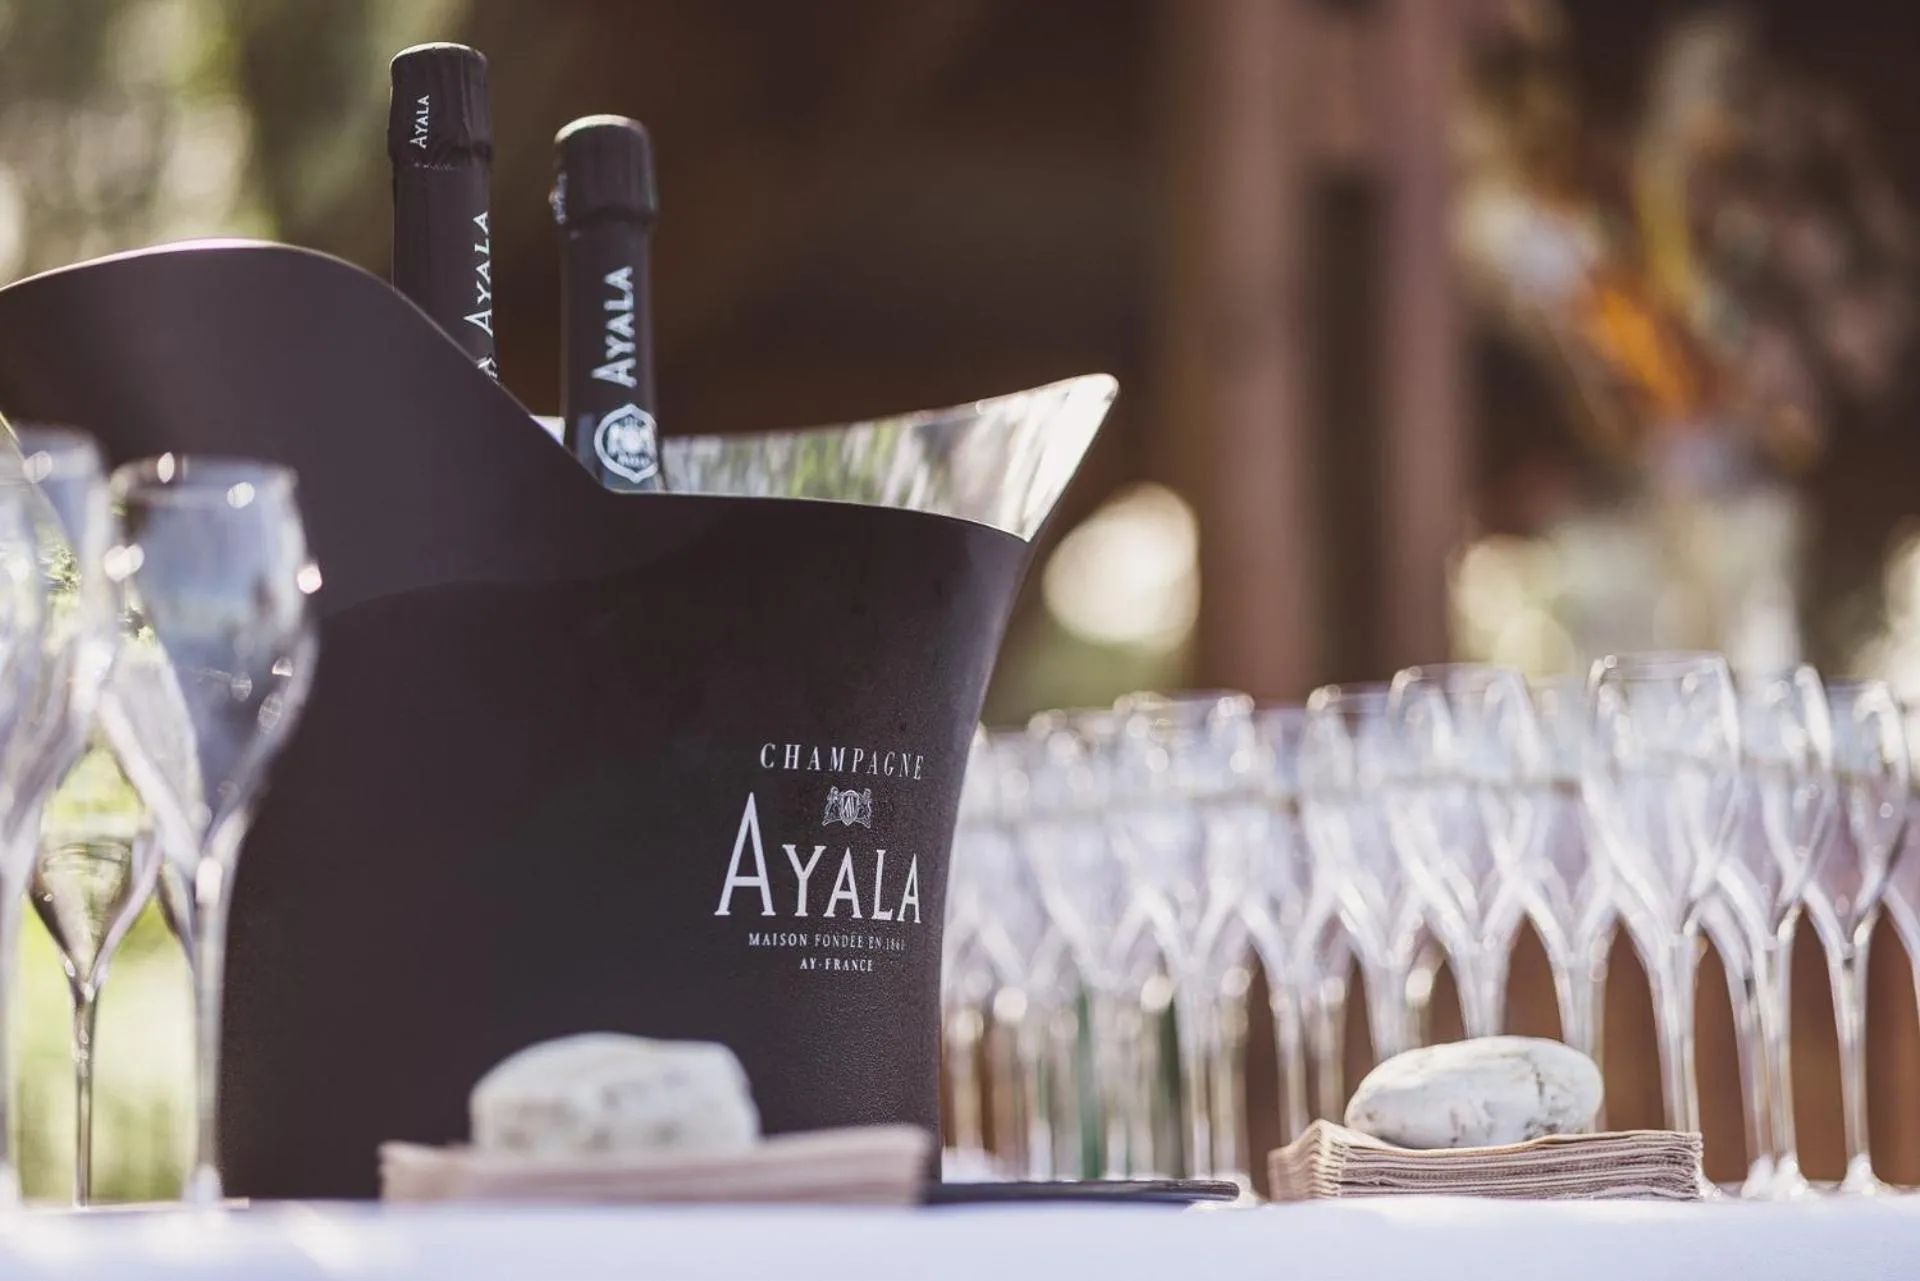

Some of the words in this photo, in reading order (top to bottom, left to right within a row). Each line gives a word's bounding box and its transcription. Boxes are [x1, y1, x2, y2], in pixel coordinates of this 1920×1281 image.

[408, 94, 431, 150] AYALA
[463, 211, 495, 339] AYALA
[591, 265, 638, 389] AYALA
[759, 742, 925, 781] CHAMPAGNE
[713, 791, 923, 924] AYALA
[748, 932, 808, 947] MAISON
[868, 936, 882, 951] EN
